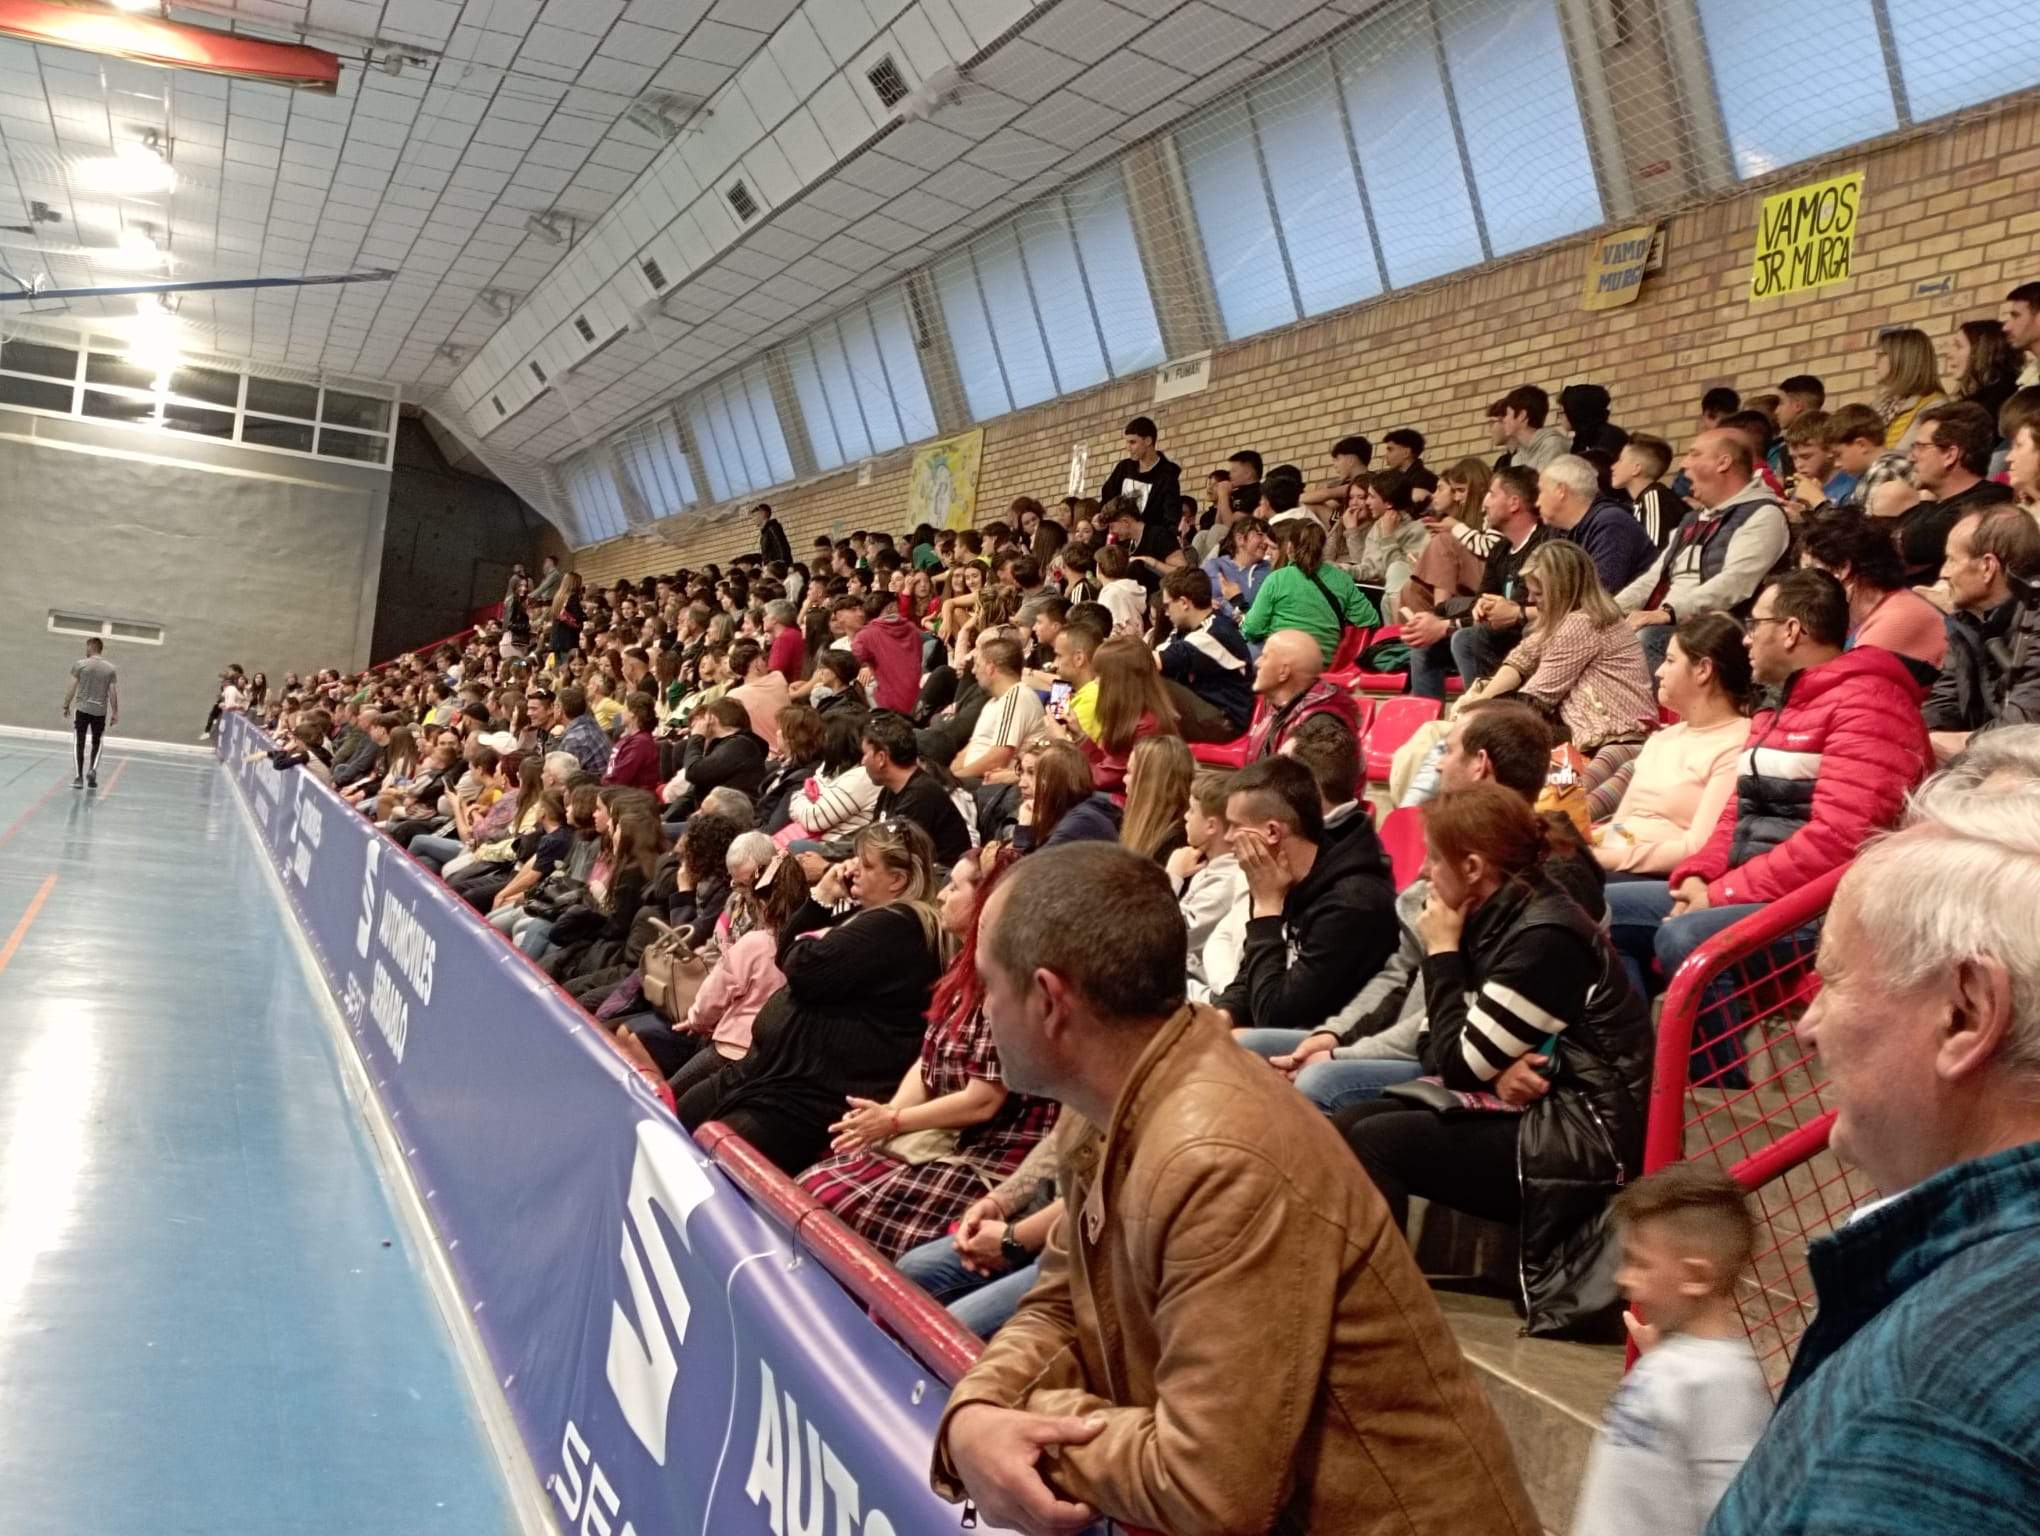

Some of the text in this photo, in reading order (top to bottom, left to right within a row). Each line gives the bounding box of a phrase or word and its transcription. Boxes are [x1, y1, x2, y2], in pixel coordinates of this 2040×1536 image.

[1764, 182, 1857, 251] VAMOS
[1754, 236, 1850, 296] JR. MURGA
[555, 1420, 637, 1536] SE
